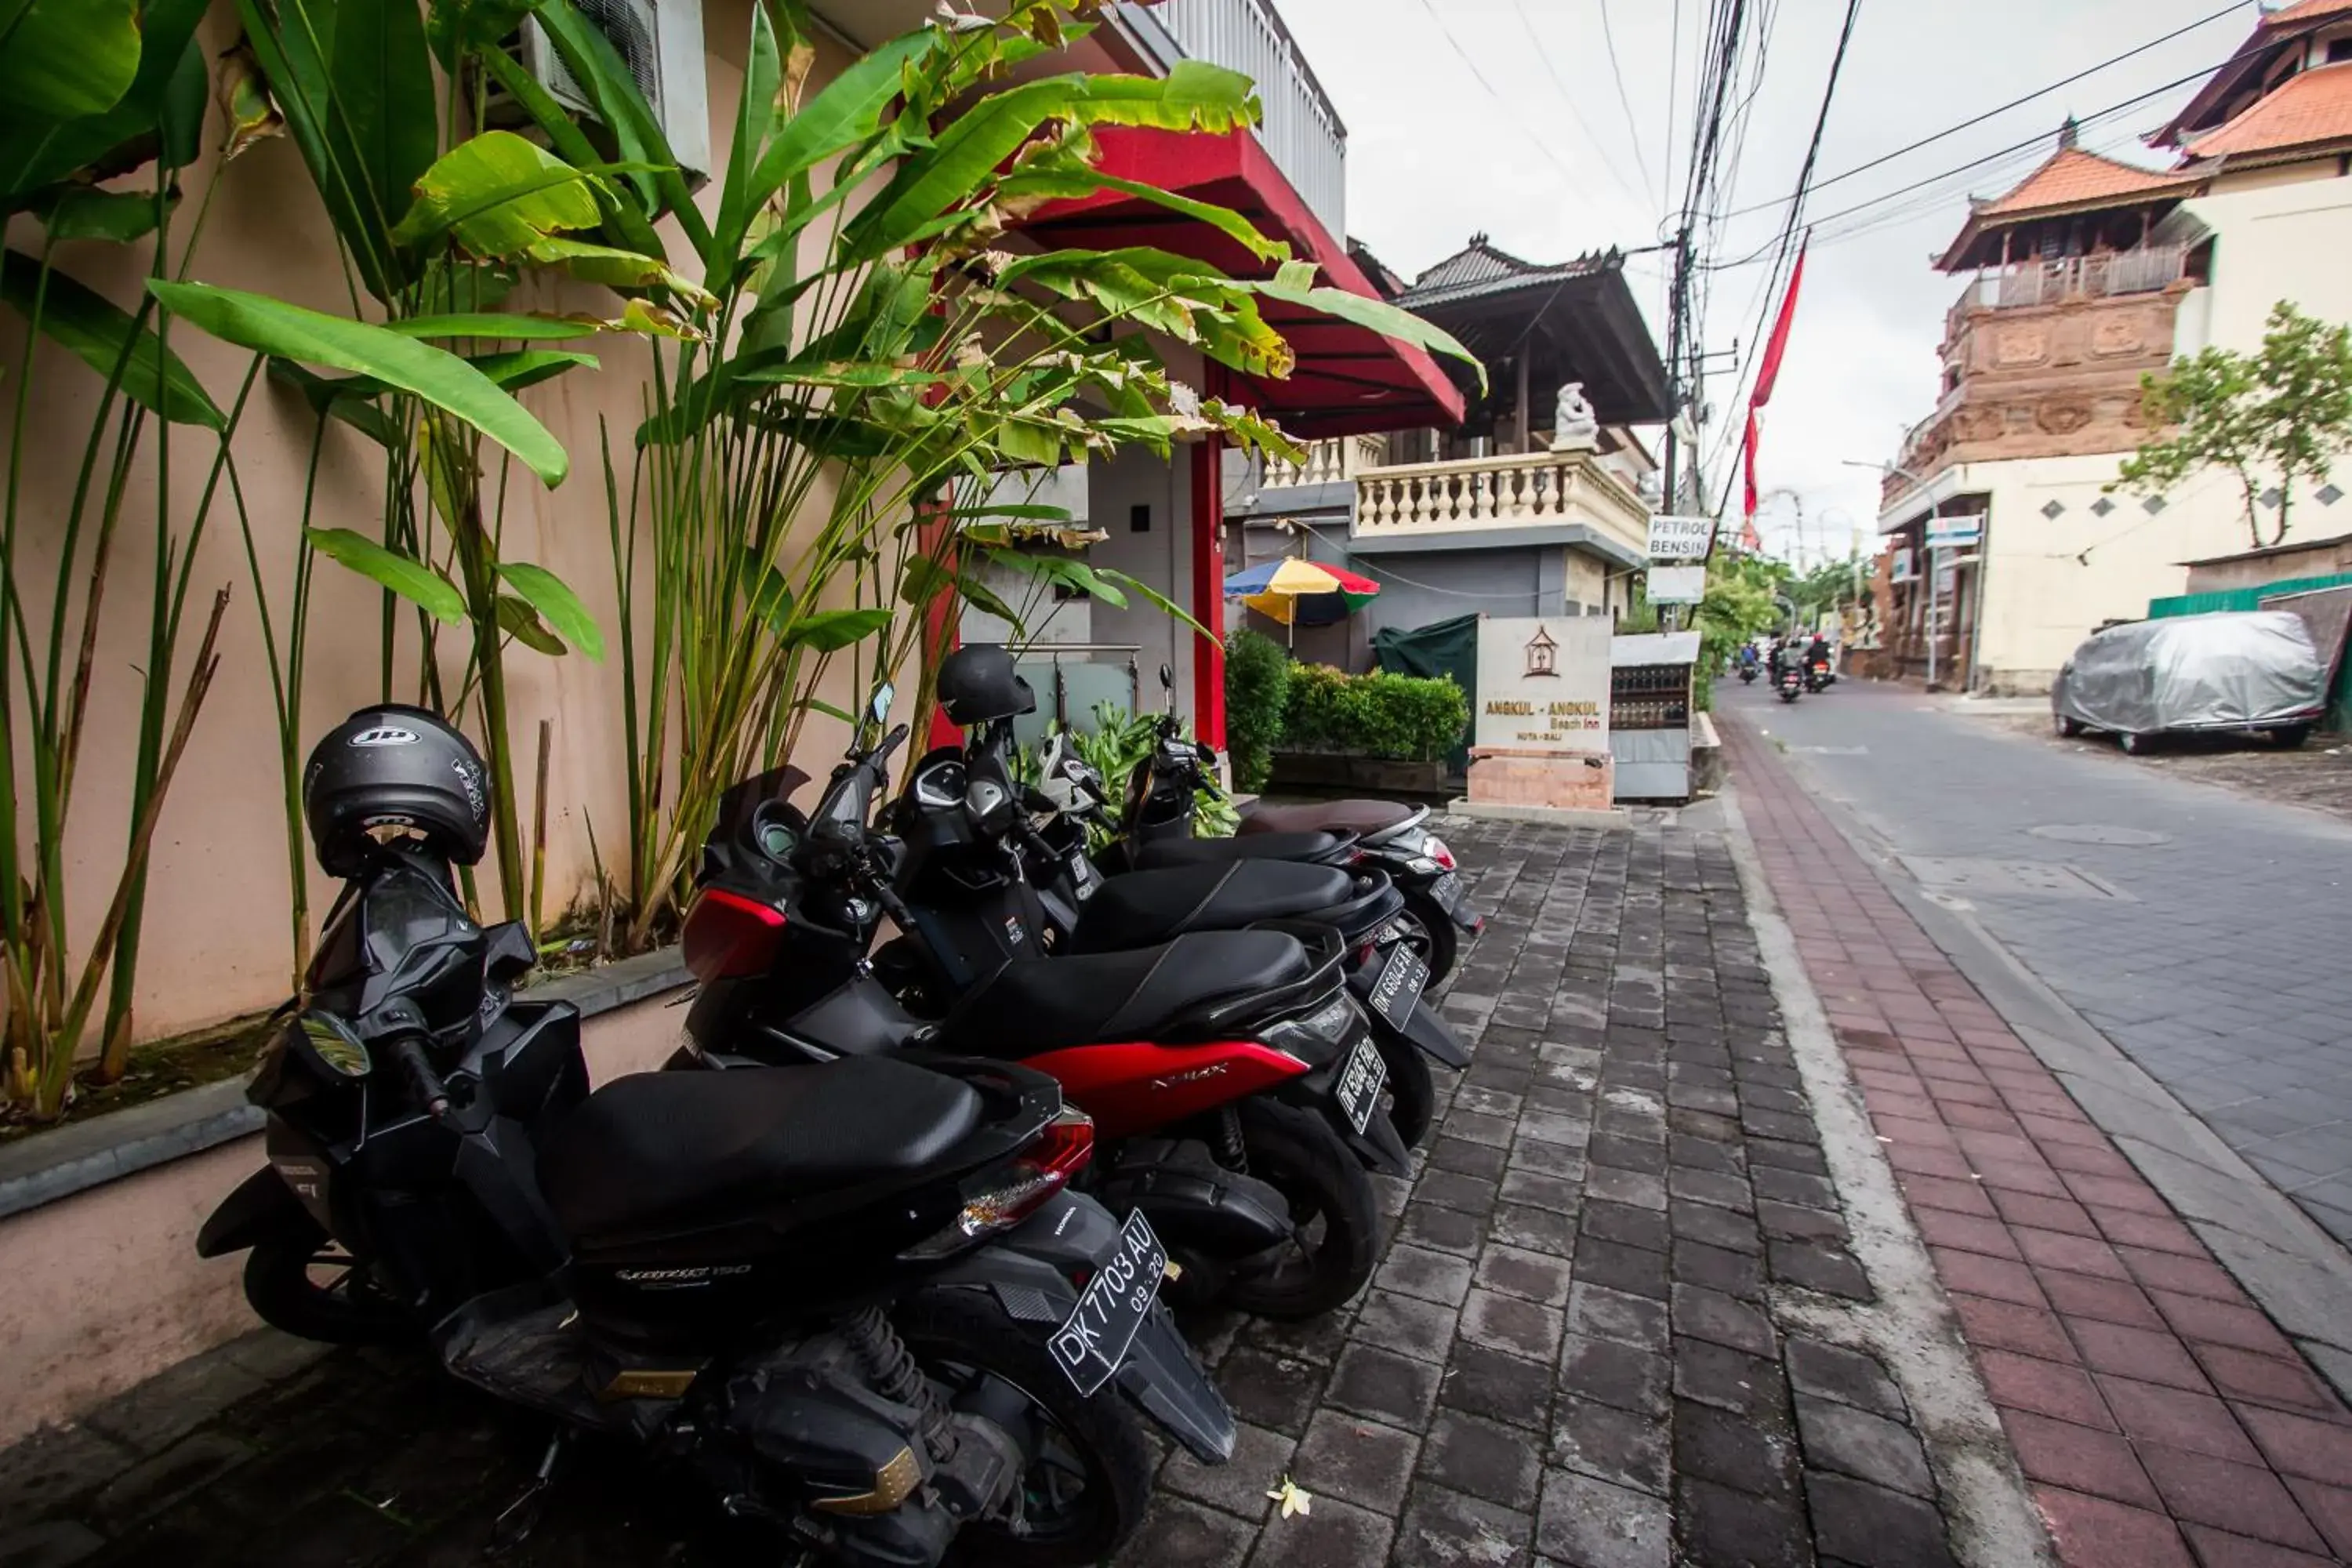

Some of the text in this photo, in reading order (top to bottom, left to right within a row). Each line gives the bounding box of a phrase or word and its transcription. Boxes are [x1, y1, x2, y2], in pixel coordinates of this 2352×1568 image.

[1650, 540, 1705, 555] BENSIN
[1486, 701, 1534, 716] ANGKUL
[1548, 702, 1599, 716] ANGKUL
[1550, 717, 1600, 730] Beach Inn
[1374, 990, 1392, 1013] DK
[1058, 1217, 1152, 1366] DK 7703 AU
